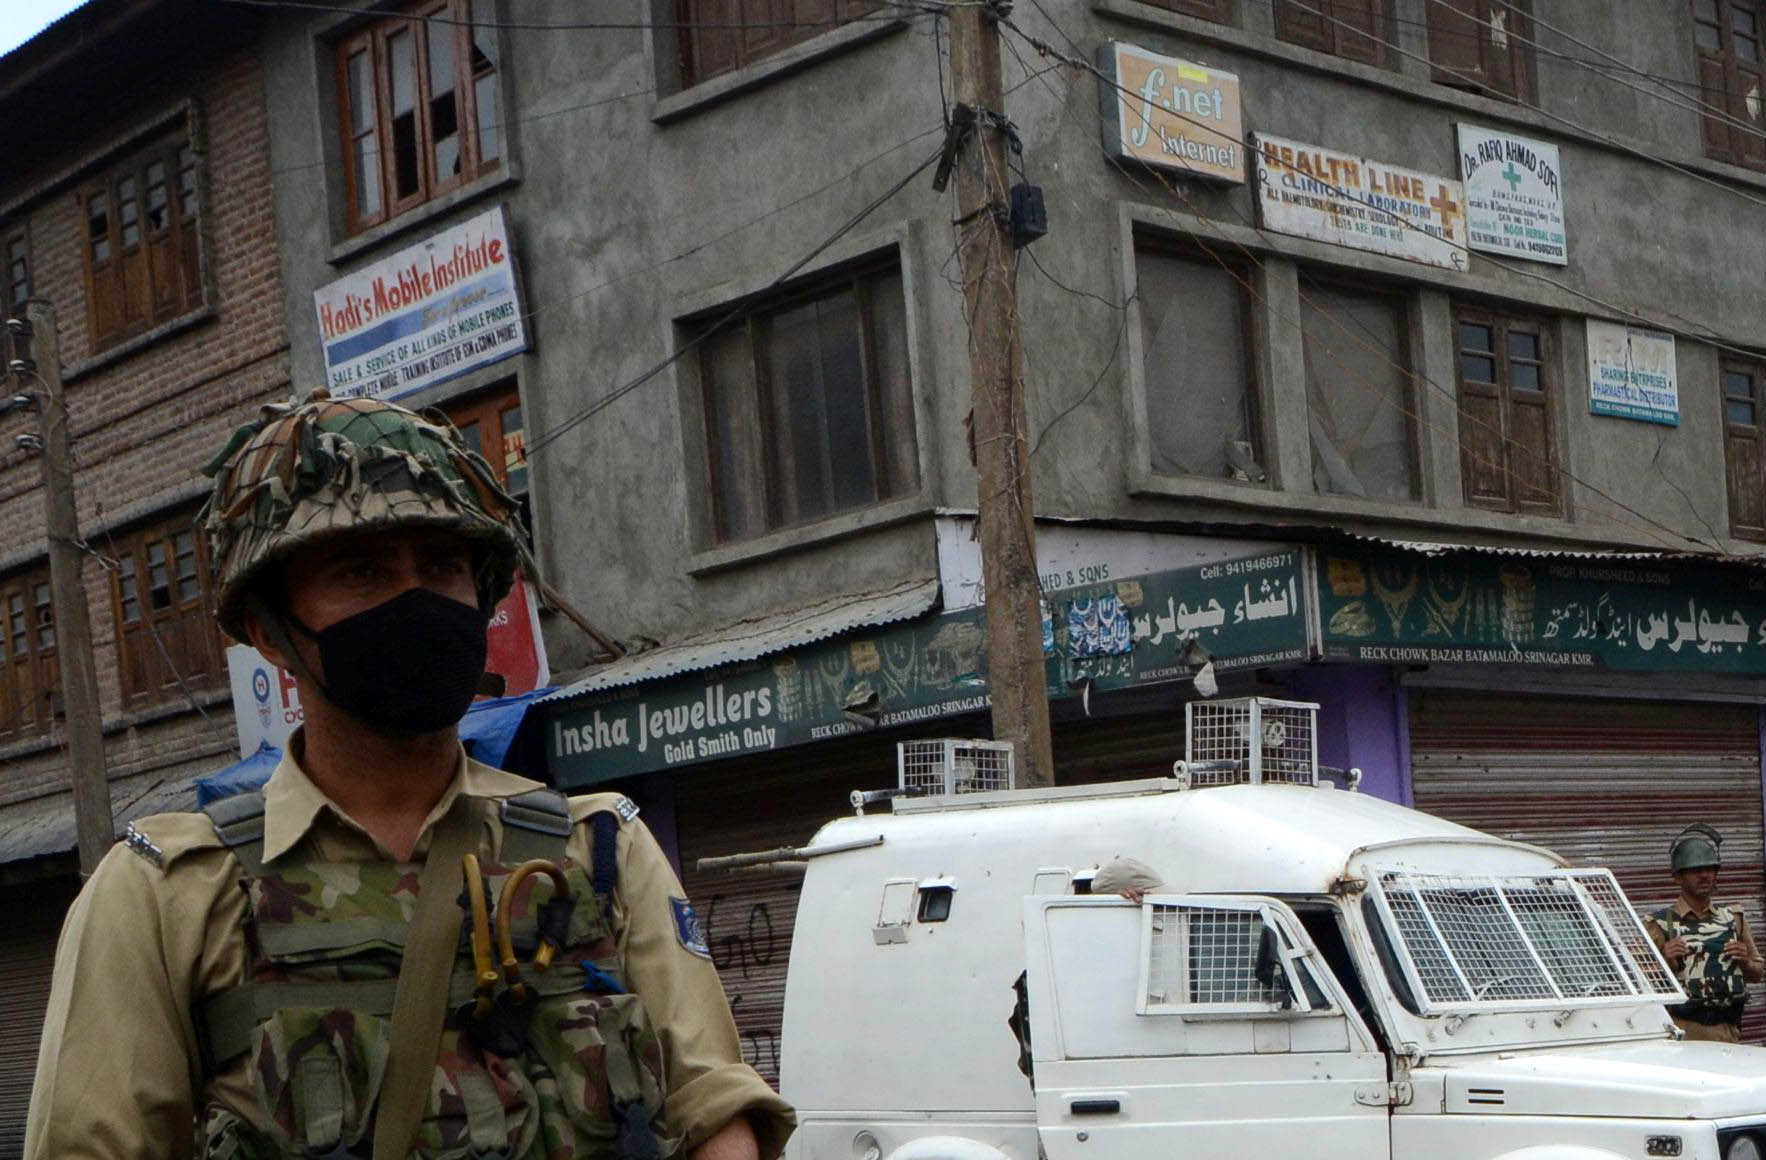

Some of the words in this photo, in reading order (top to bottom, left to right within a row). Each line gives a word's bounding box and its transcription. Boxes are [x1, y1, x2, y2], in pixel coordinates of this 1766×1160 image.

[1160, 126, 1237, 168] Internet
[1367, 168, 1426, 203] LINE
[1477, 139, 1505, 165] RAFIQ
[1505, 140, 1537, 172] AHMAD
[1537, 160, 1560, 200] SOFI
[320, 292, 374, 338] Hadi's
[373, 264, 433, 316] Mobile
[430, 236, 505, 291] Institute
[332, 367, 353, 388] SALE
[411, 339, 426, 357] ALL
[458, 314, 486, 338] MOBILE
[485, 301, 515, 326] PHONES
[1360, 646, 1388, 660] RECK
[1389, 647, 1430, 661] CHOWK
[1431, 648, 1463, 661] BAZAR
[1465, 649, 1523, 663] BATAMALOO
[1524, 651, 1570, 665] SRINAGAR
[555, 710, 630, 758] Insha
[638, 683, 773, 753] Jewellers
[889, 704, 942, 726] BATAMALOO
[941, 696, 986, 714] SRINAGAR
[664, 741, 695, 764] Gold
[697, 730, 741, 757] Smith
[743, 724, 777, 749] Only
